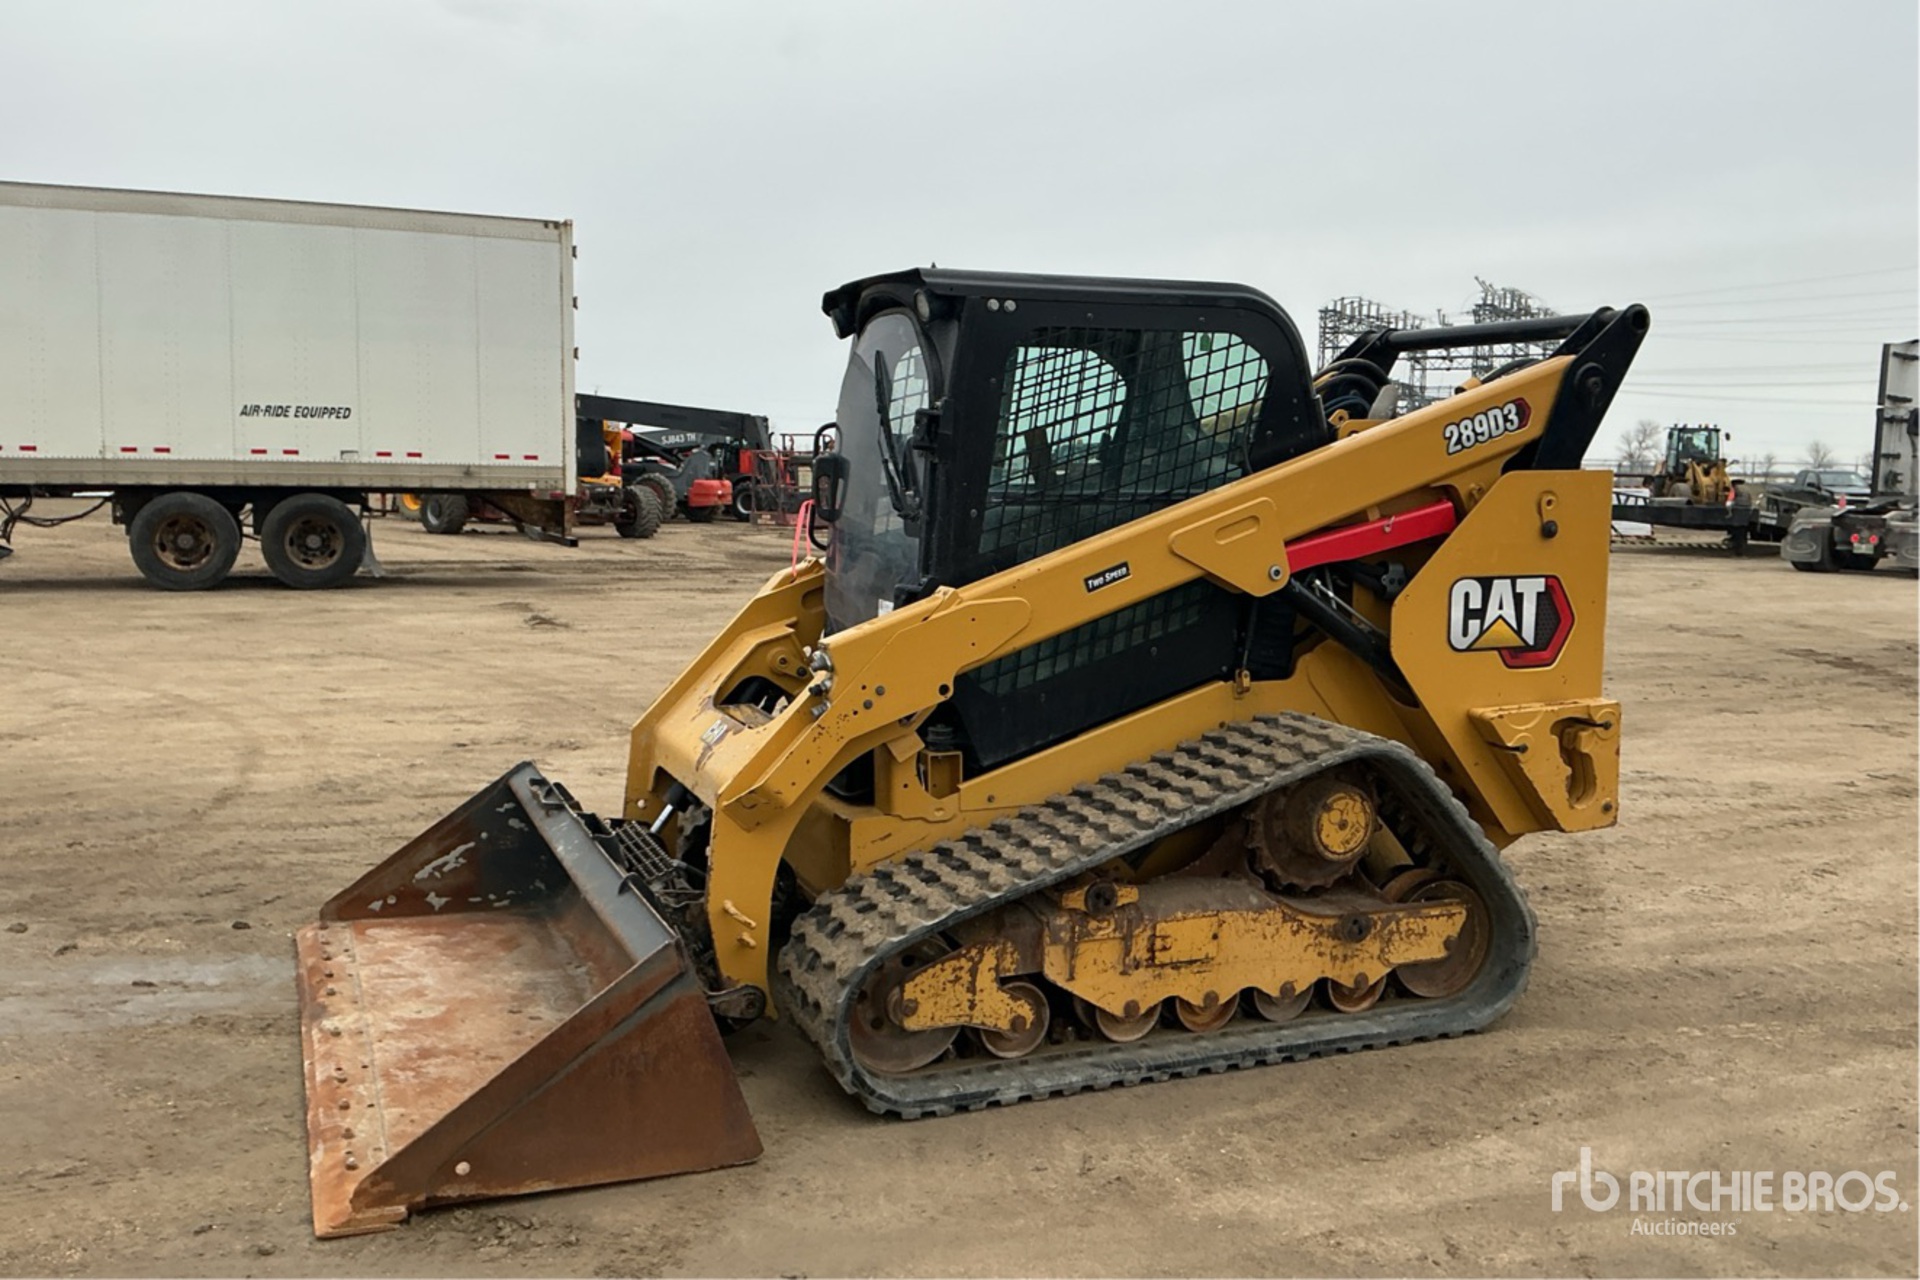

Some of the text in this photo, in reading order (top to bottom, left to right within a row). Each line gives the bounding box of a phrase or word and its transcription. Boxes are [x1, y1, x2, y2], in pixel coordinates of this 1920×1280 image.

[239, 404, 352, 419] AIR-RIDE EQUIPPED
[1444, 402, 1520, 454] 289D3
[1450, 577, 1546, 650] CAT
